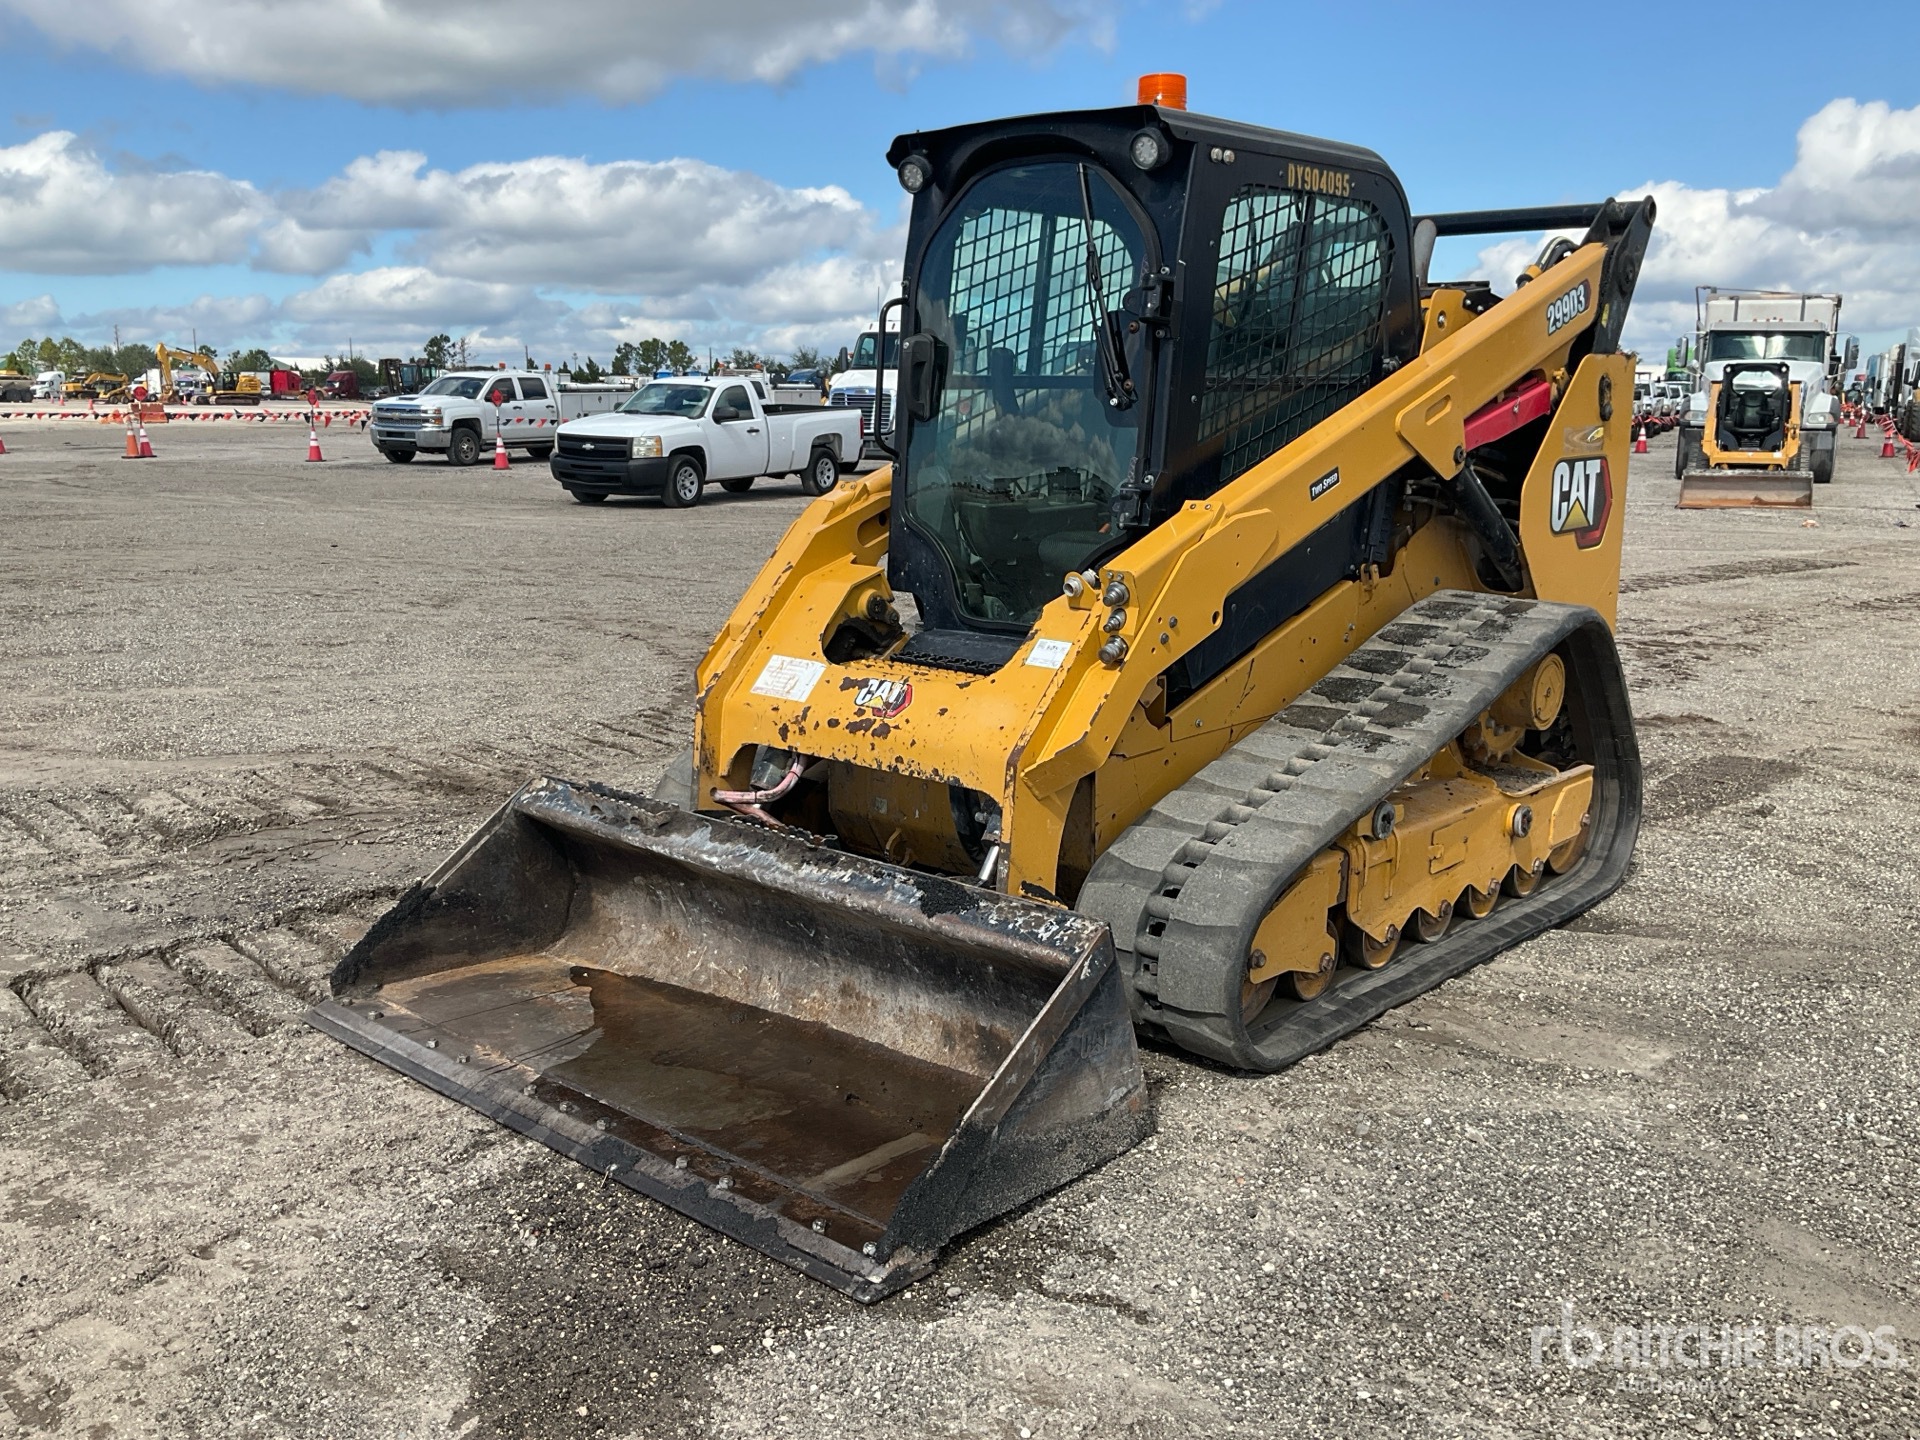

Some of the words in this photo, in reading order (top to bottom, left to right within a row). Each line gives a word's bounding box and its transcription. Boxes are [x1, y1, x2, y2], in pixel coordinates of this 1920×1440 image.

[1288, 163, 1350, 197] DY904095
[1547, 284, 1586, 335] 299D3
[1552, 459, 1601, 532] CAT
[856, 679, 904, 706] CAT
